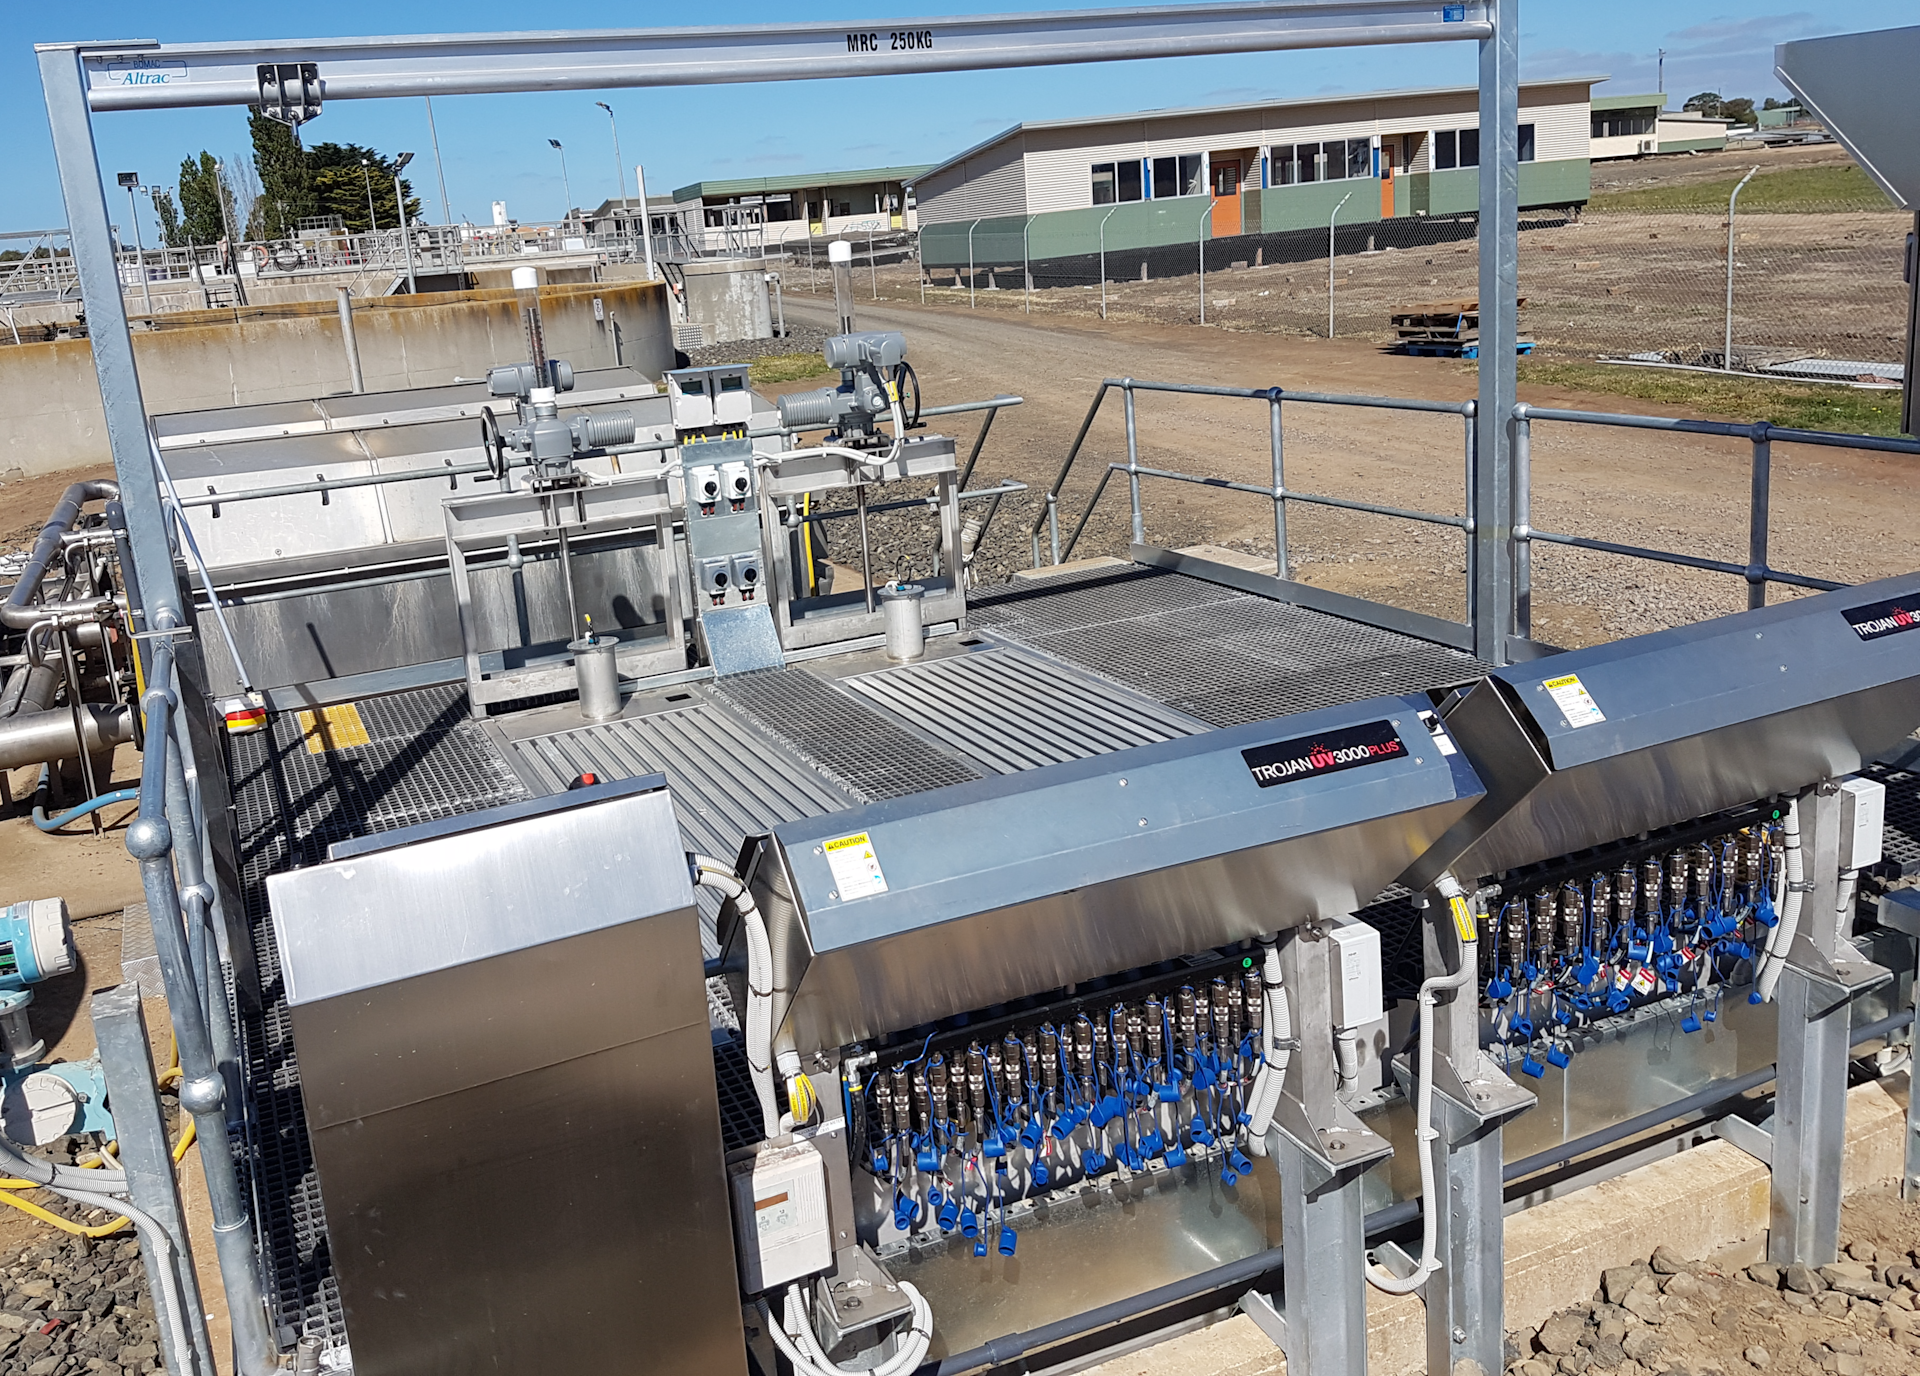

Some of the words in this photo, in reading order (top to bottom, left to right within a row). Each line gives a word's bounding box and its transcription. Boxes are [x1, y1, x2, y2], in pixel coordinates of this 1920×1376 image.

[846, 32, 878, 53] MRC
[890, 30, 933, 51] 250KG
[133, 59, 161, 69] BOMAC
[122, 72, 170, 85] Altrac
[1552, 677, 1576, 687] CAUTION
[834, 836, 866, 849] CAUTION
